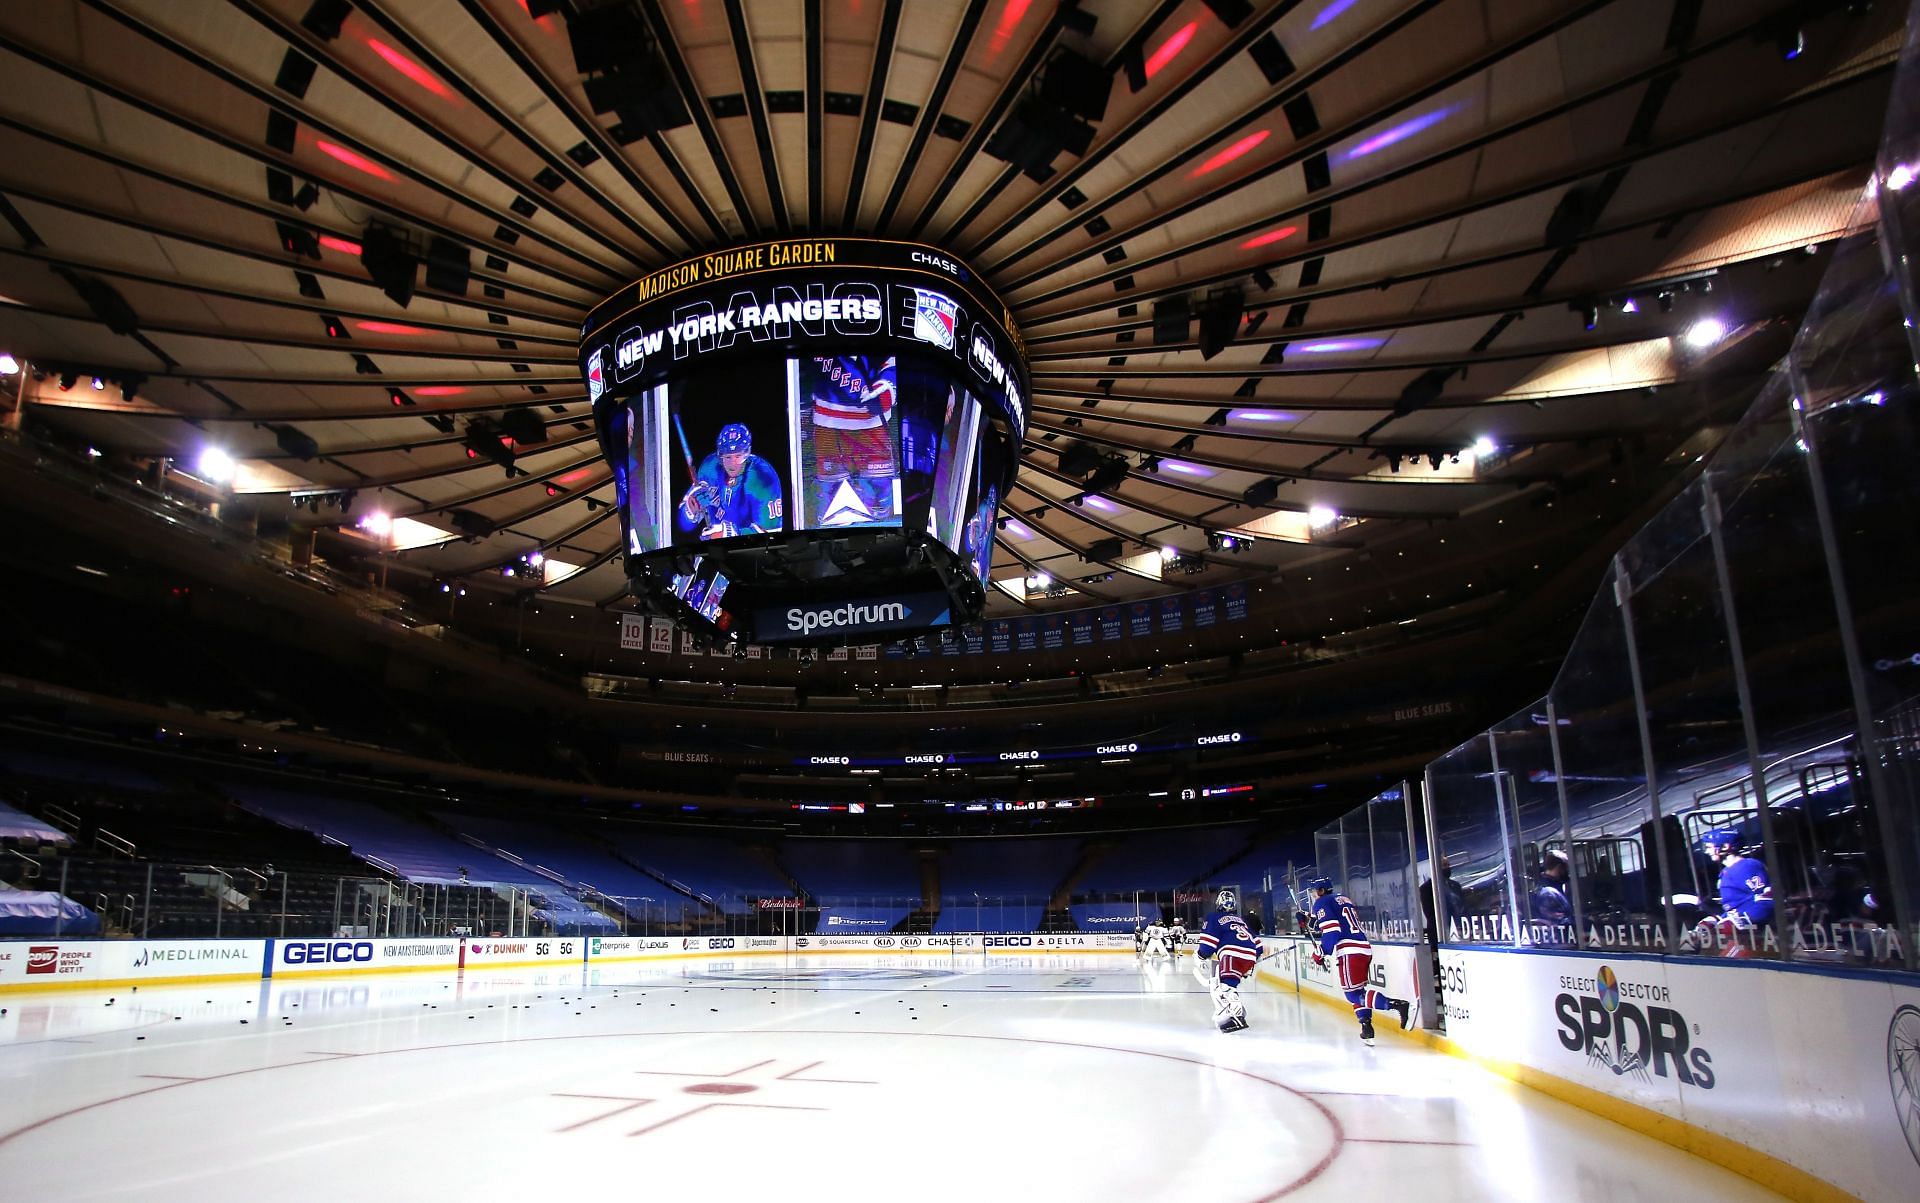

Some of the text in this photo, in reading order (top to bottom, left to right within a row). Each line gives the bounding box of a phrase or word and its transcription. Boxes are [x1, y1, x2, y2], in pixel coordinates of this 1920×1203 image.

[911, 252, 958, 275] CHASE
[639, 243, 835, 302] MADISON SQUARE GARDEN
[919, 295, 938, 309] NEW
[618, 298, 882, 369] NEW YORK RANGERS
[924, 308, 952, 345] RANGERS
[974, 337, 1005, 385] NEW
[767, 498, 783, 519] 16
[786, 602, 904, 636] Spectrum
[625, 624, 640, 638] 10
[655, 628, 669, 642] 12
[1393, 702, 1453, 721] BLUE SEATS
[1197, 734, 1231, 745] CHASE
[999, 752, 1030, 760] CHASE
[1096, 744, 1128, 754] CHASE
[664, 752, 709, 764] BLUE SEATS
[810, 756, 841, 765] CHASE
[905, 755, 935, 763] CHASE
[1387, 919, 1416, 938] DELTA
[1461, 914, 1513, 941] DELTA
[1532, 924, 1577, 944] DELTA
[928, 938, 963, 946] CHASE
[984, 937, 1032, 946] GEICO
[1605, 923, 1666, 948] DELTA
[1698, 924, 1779, 953] DELTA
[1814, 923, 1904, 959] DELTA
[383, 944, 455, 957] NEW AMSTERDAM VODKA
[493, 943, 528, 954] DUNKIN'
[536, 942, 550, 955] 5G
[560, 942, 573, 954] 5G
[596, 941, 630, 952] enterprise
[646, 941, 669, 949] LEXUS
[709, 938, 735, 949] GEICO
[152, 948, 249, 961] MEDLIMINAL
[283, 942, 373, 964] GEICO
[1560, 975, 1671, 1003] SELECT SECTOR
